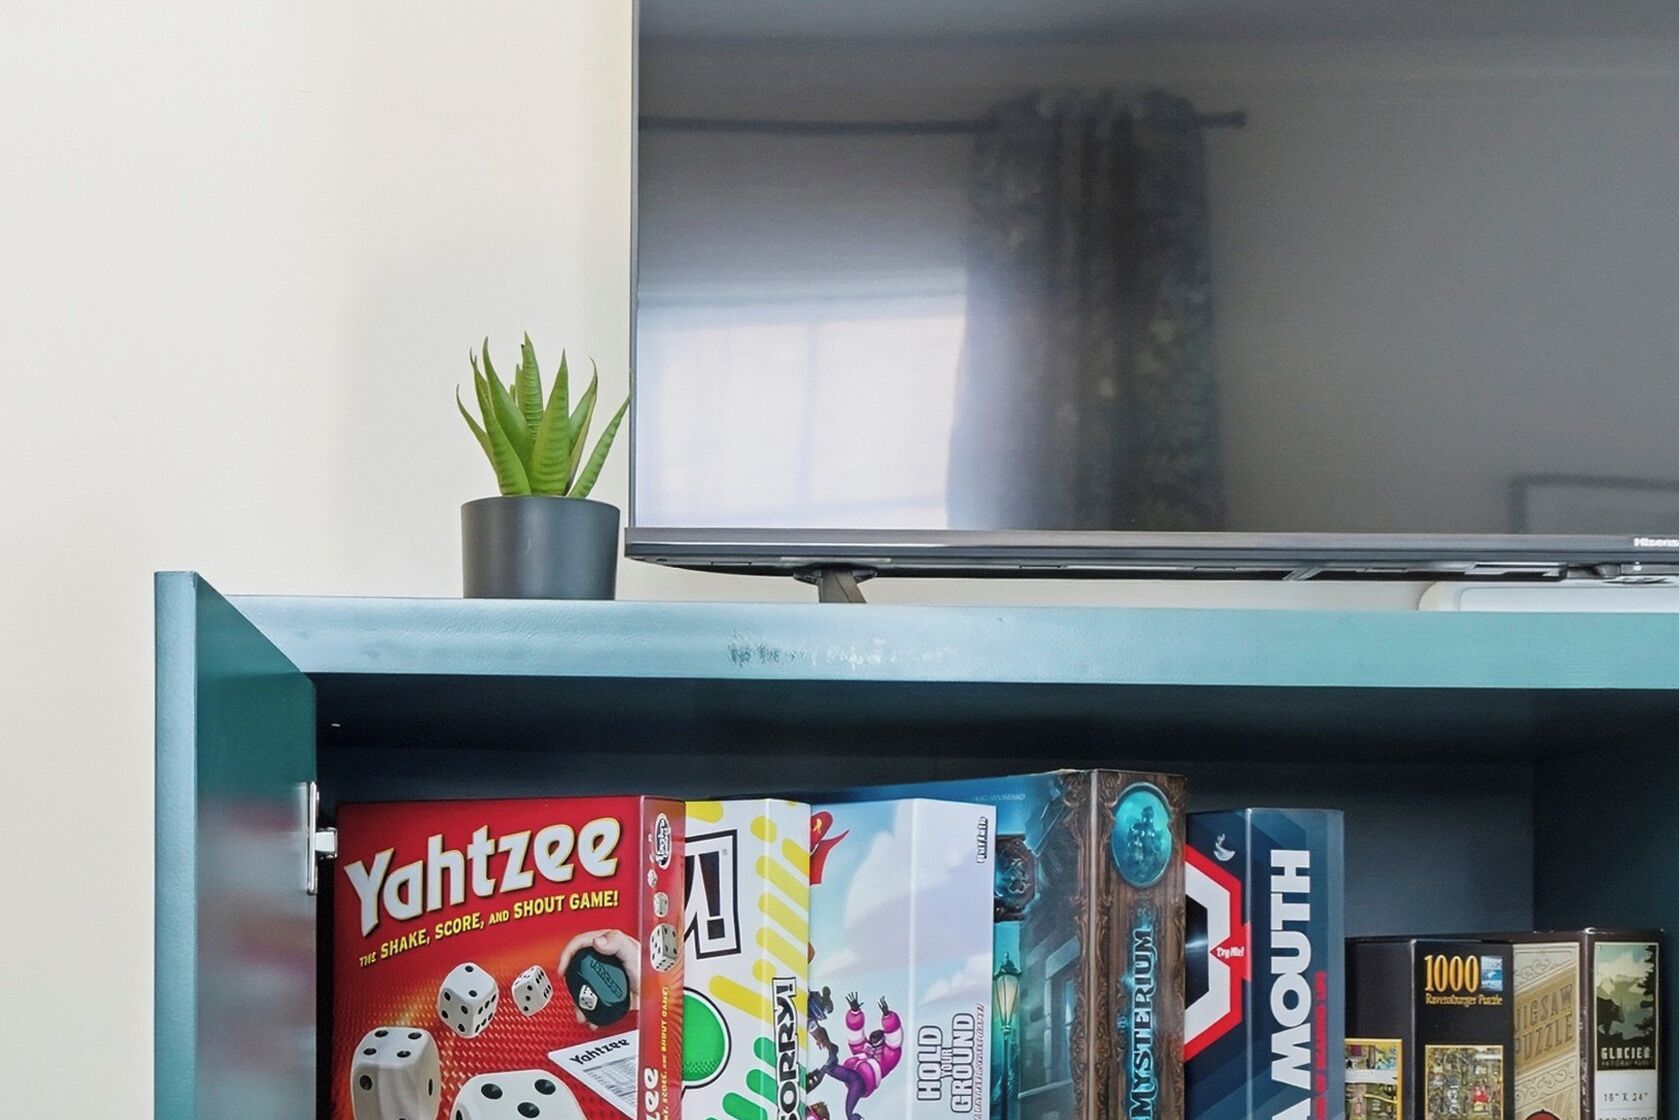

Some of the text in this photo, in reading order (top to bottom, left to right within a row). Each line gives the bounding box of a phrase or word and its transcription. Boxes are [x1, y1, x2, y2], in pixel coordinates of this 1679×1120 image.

[344, 817, 620, 937] Yahtzee
[380, 928, 431, 959] SHAKE,
[434, 913, 485, 940] SCORE,
[488, 909, 509, 925] AND
[513, 895, 565, 919] SHOUT
[569, 890, 619, 909] GAME!
[1271, 850, 1311, 1090] MOUTH
[1424, 954, 1479, 993] 1000
[570, 1038, 630, 1065] Yahtzee
[1130, 927, 1158, 1120] MYSTERIUM
[917, 1026, 942, 1100] HOLD
[941, 1047, 952, 1079] YOUR
[951, 1013, 975, 1113] GROUND
